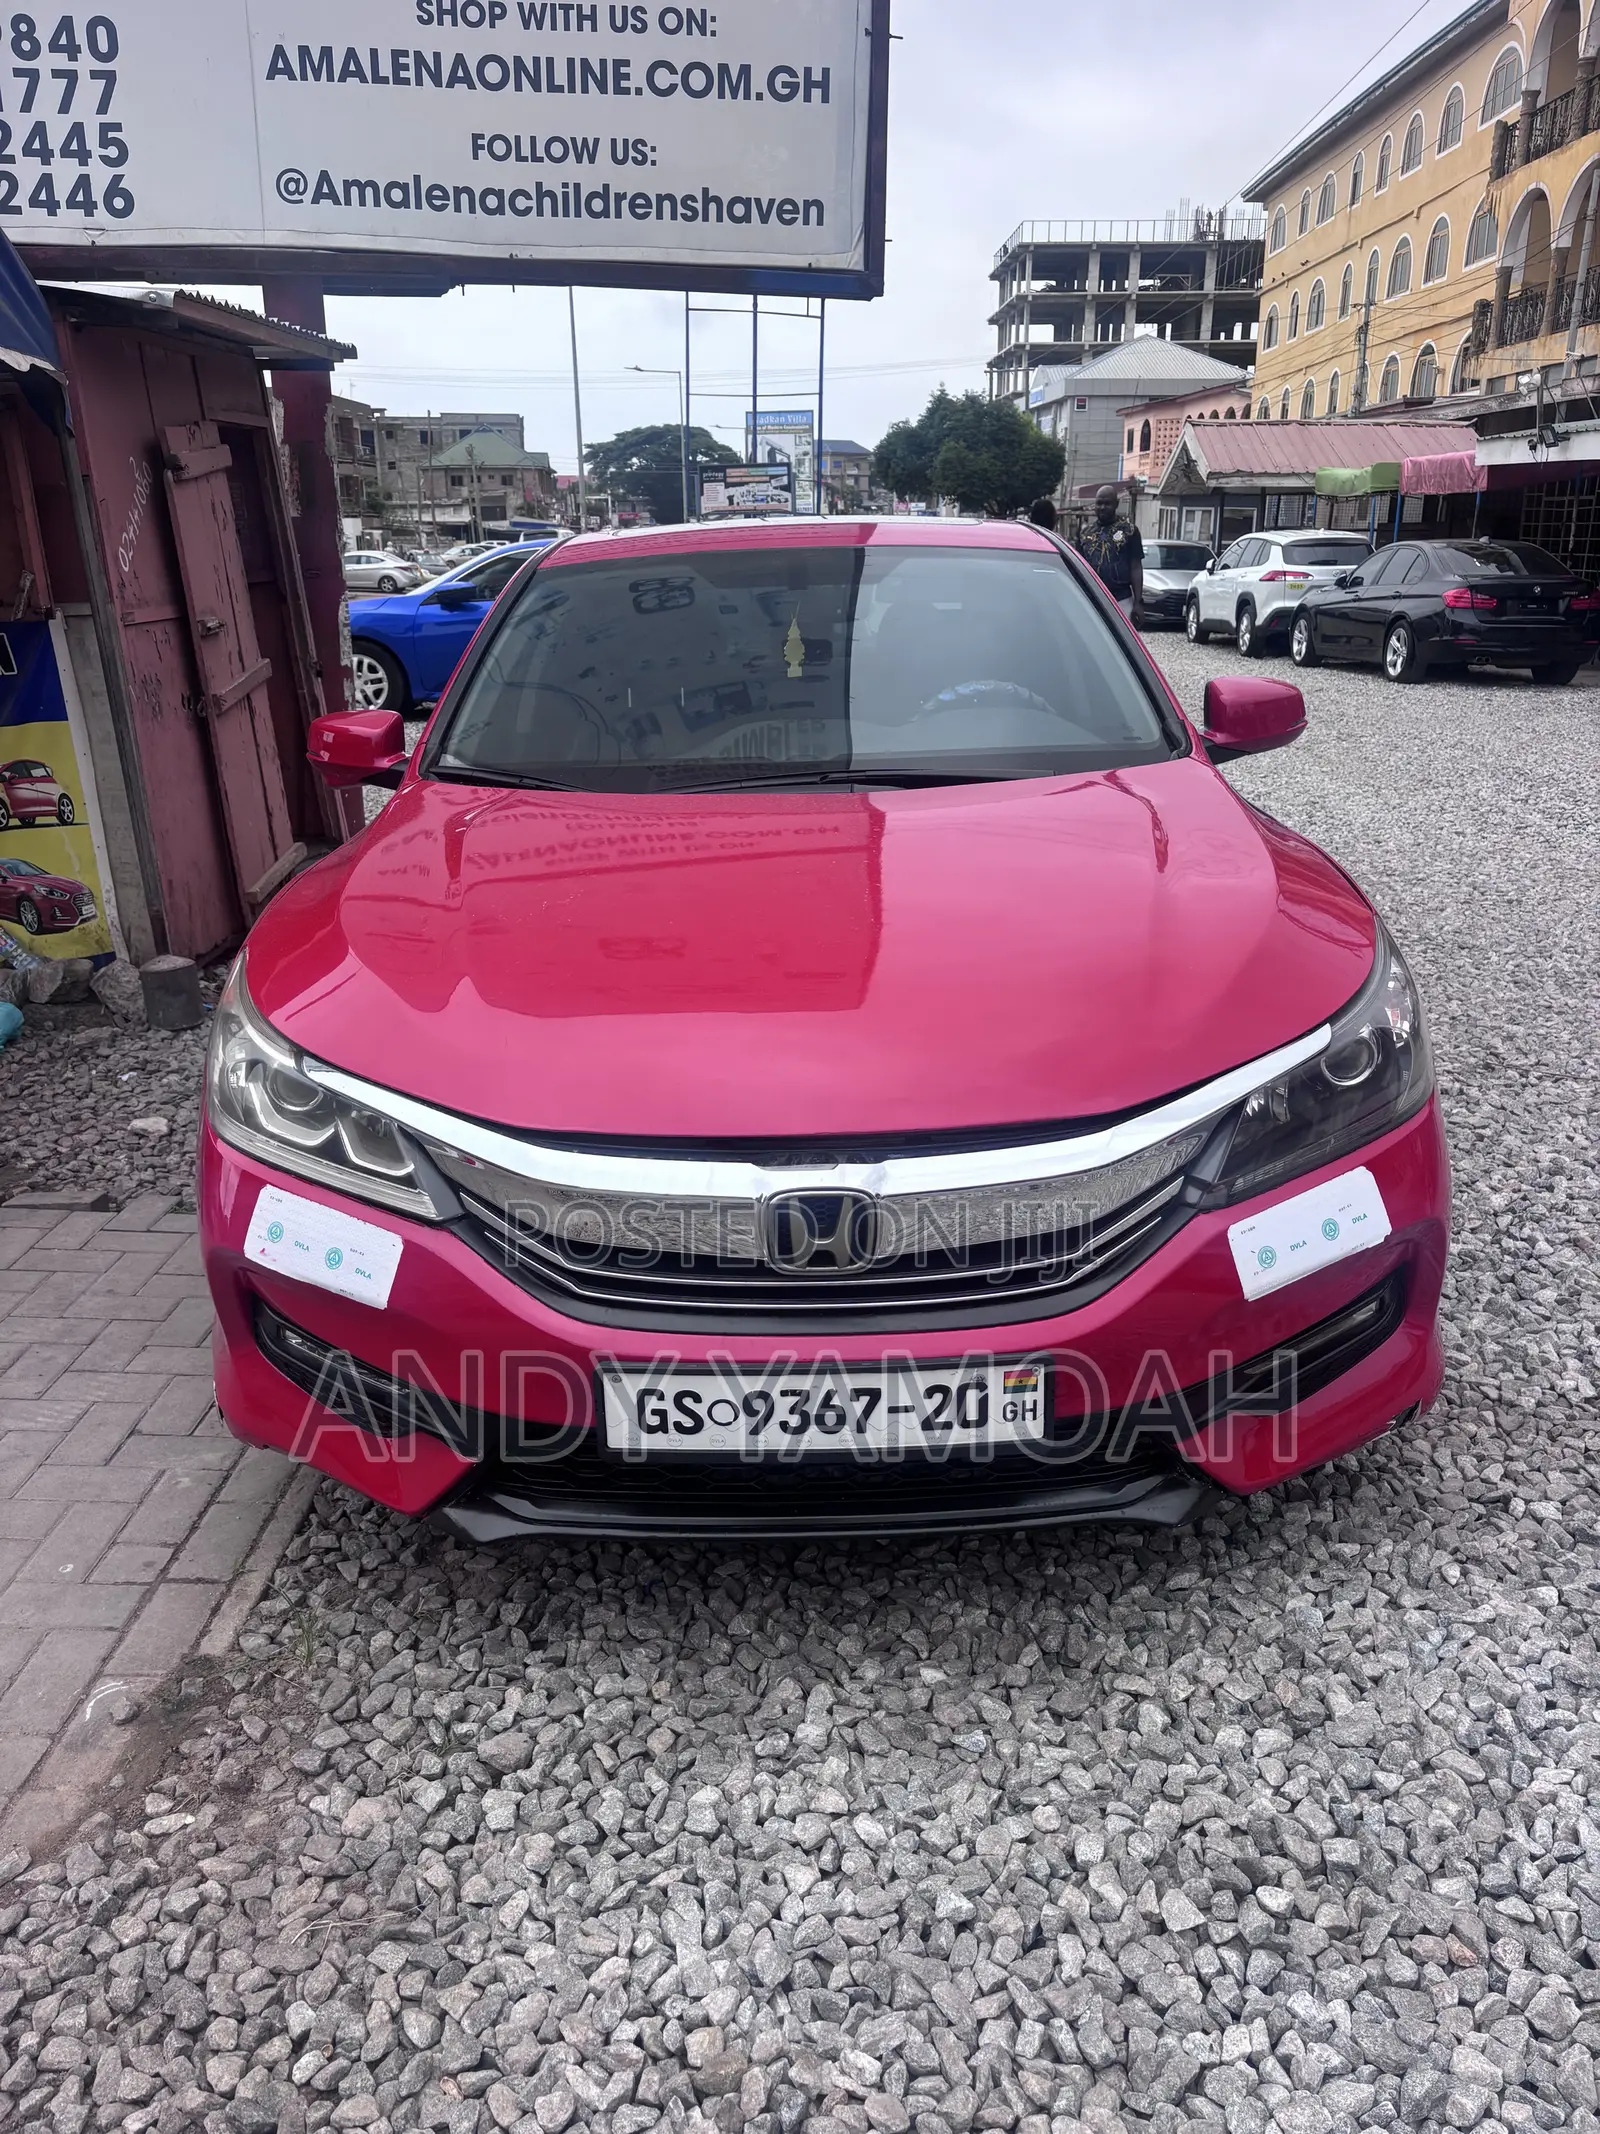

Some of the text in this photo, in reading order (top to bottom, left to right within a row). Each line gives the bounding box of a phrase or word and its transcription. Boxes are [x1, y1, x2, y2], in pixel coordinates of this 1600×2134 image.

[416, 0, 718, 37] SHOP WITH US ON:
[265, 44, 832, 104] AMALENAONLINE.COM.GH
[471, 133, 658, 166] FOLLOW US:
[0, 170, 135, 219] 2446
[276, 167, 825, 226] @Amalenachildrenshaven
[1351, 1212, 1368, 1225] DVLA
[294, 1240, 311, 1253] DVLA
[1290, 1239, 1308, 1252] DVLA
[354, 1267, 373, 1280] DVLA
[636, 1382, 1038, 1436] GS 9367-20 GH
